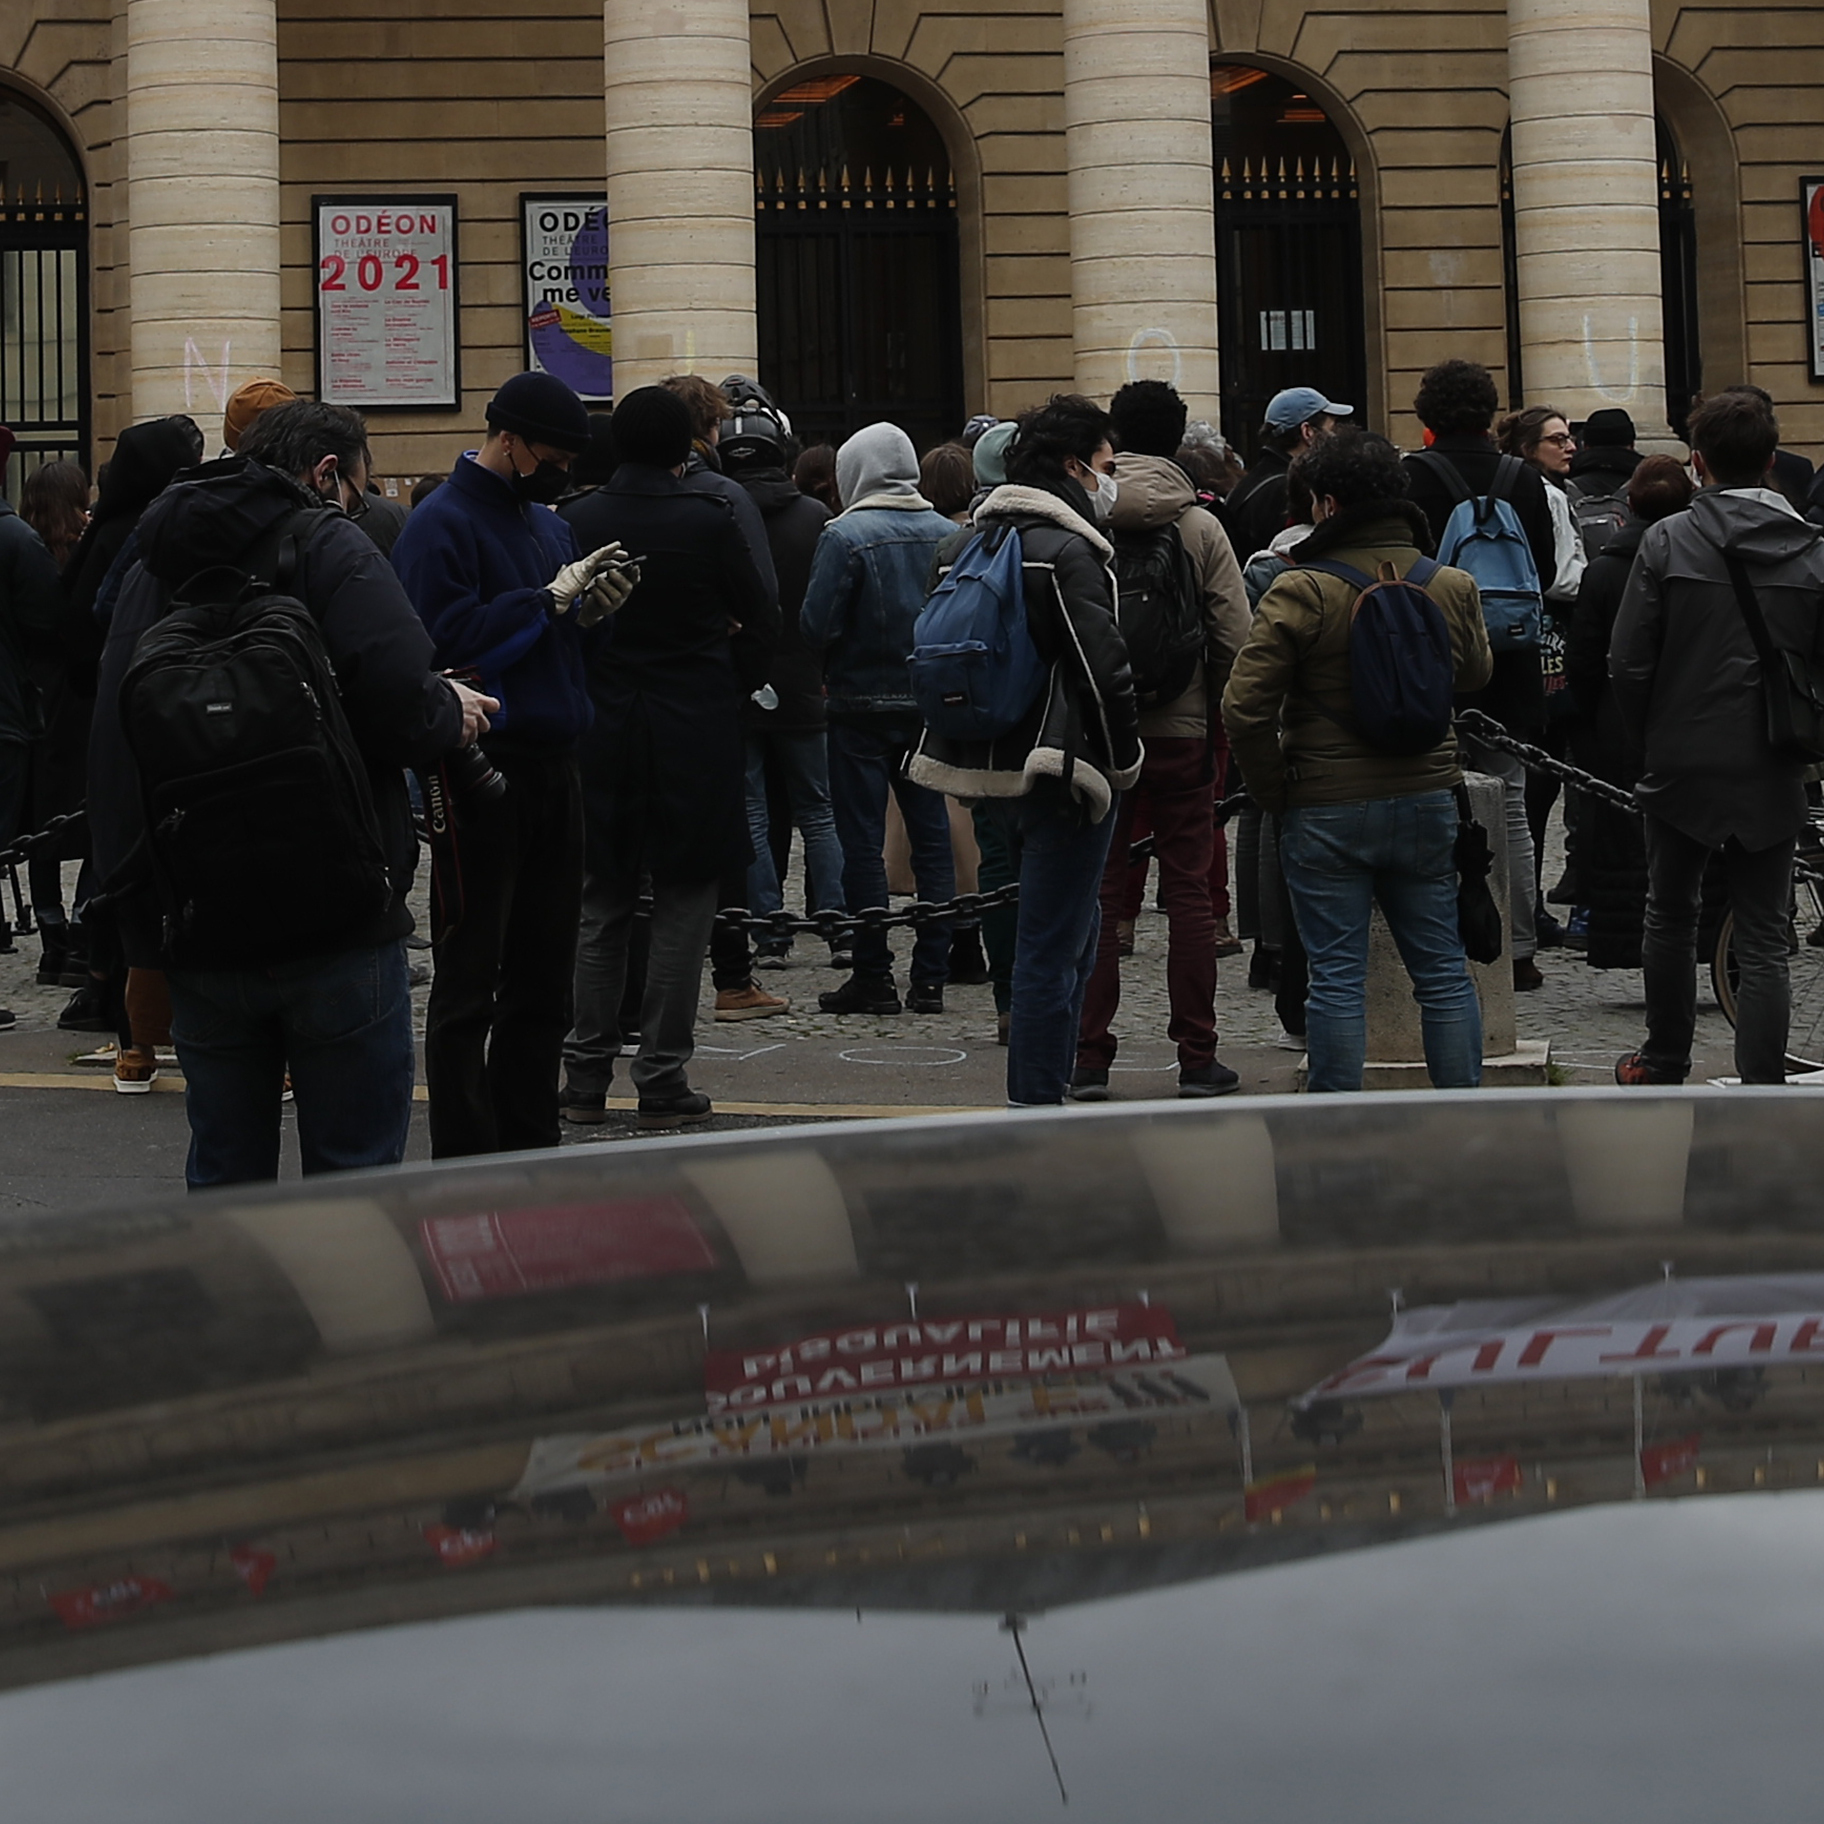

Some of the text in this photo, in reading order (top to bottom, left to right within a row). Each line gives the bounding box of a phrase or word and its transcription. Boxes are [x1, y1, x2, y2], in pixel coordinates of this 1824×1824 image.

[330, 209, 437, 235] ODÉON
[538, 205, 608, 233] ODÉ
[543, 245, 609, 256] DE L'EURO
[320, 253, 449, 292] 2021
[529, 261, 609, 282] Comm
[542, 286, 611, 303] me ve
[427, 773, 446, 835] Canon
